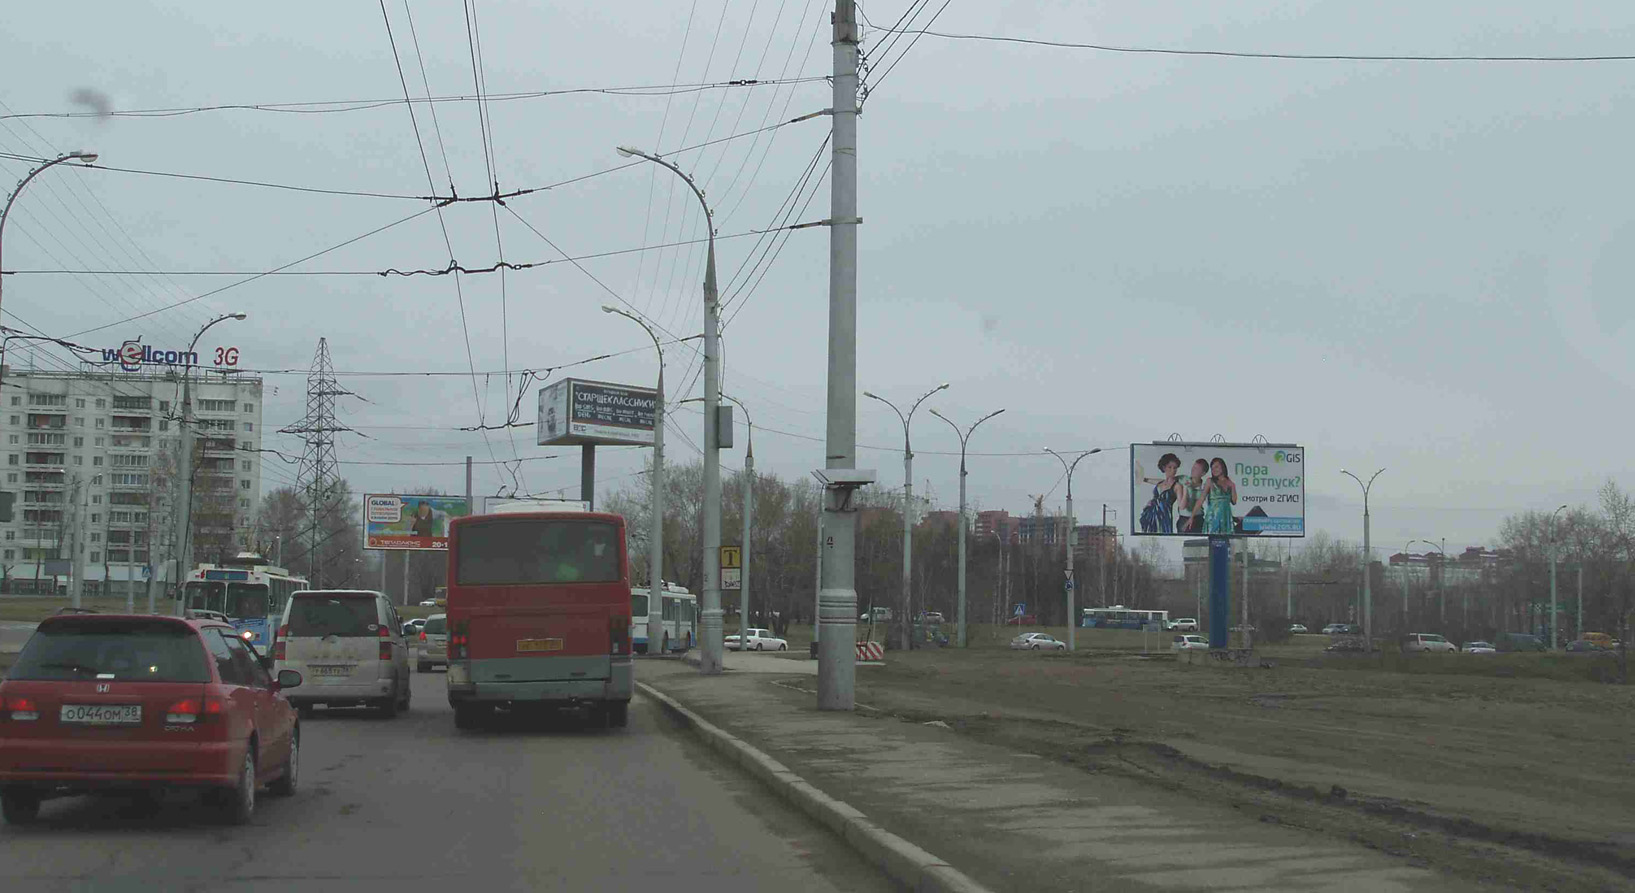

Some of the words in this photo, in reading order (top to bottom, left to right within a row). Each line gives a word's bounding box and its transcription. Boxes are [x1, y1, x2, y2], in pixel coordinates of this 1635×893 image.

[213, 347, 239, 366] 3G
[1235, 463, 1268, 477] Пора
[1253, 476, 1301, 490] отпуск?
[1242, 495, 1268, 503] смотри
[1277, 494, 1299, 503] 2ГИС!
[124, 706, 138, 717] 38
